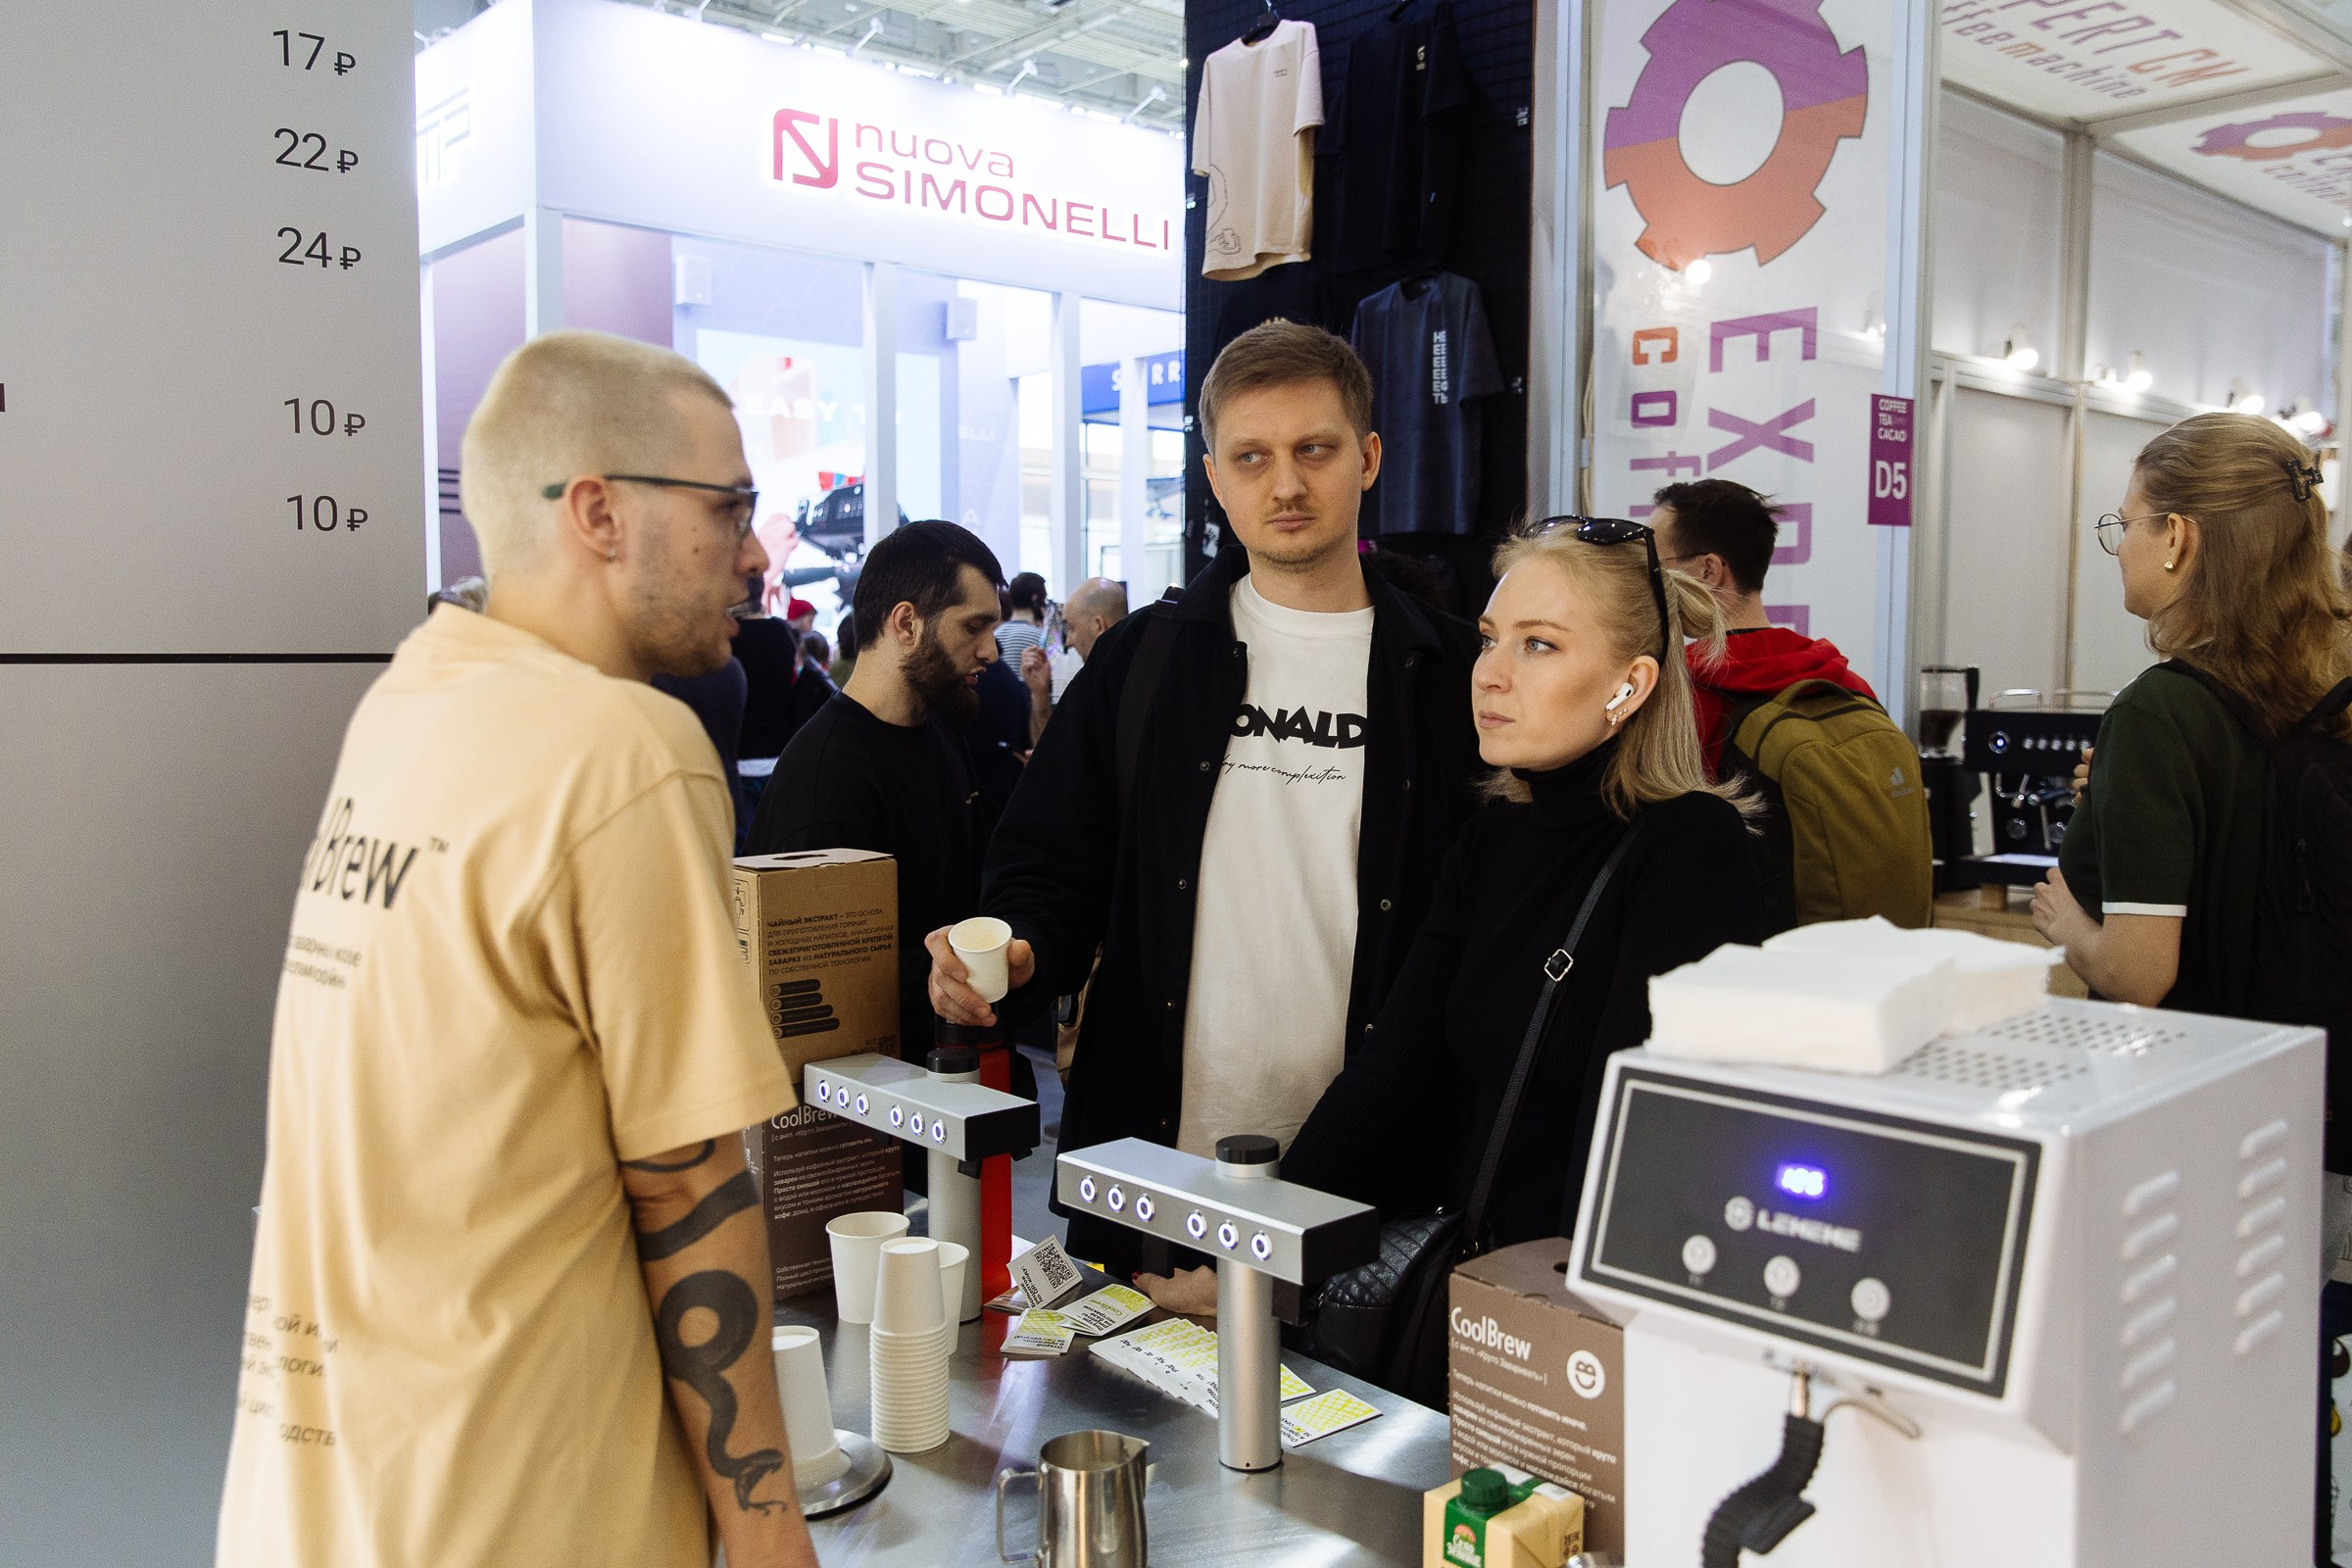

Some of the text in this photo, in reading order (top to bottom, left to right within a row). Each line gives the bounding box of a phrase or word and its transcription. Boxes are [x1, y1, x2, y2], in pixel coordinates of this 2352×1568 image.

[854, 122, 1015, 179] nuova
[855, 162, 1170, 251] SIMONELLI
[1879, 399, 1908, 414] COFFEE
[1879, 414, 1892, 425] TEA
[1878, 427, 1907, 443] CACAO
[1875, 460, 1908, 500] D5
[1230, 704, 1368, 749] ONALD
[767, 917, 802, 929] ЧАЙНЫЙ
[804, 913, 837, 924] ЭКСТРАКТ
[784, 923, 838, 936] ПРИГОТОВЛЕНИЯ
[840, 919, 867, 928] ГОРЯЧИХ
[768, 933, 893, 957] СВЕЖЕПРИГОТОВЛЕННОЙ КРЕПКОЙ
[774, 937, 811, 947] ХОЛОДНЫХ
[851, 925, 894, 936] АНАЛОГИЧНАЯ
[768, 957, 801, 966] ЗАВАРКЕ
[813, 948, 868, 960] НАТУРАЛЬНОГО
[781, 962, 828, 974] СОБСТВЕННОЙ
[1450, 1306, 1532, 1361] CoolBrew
